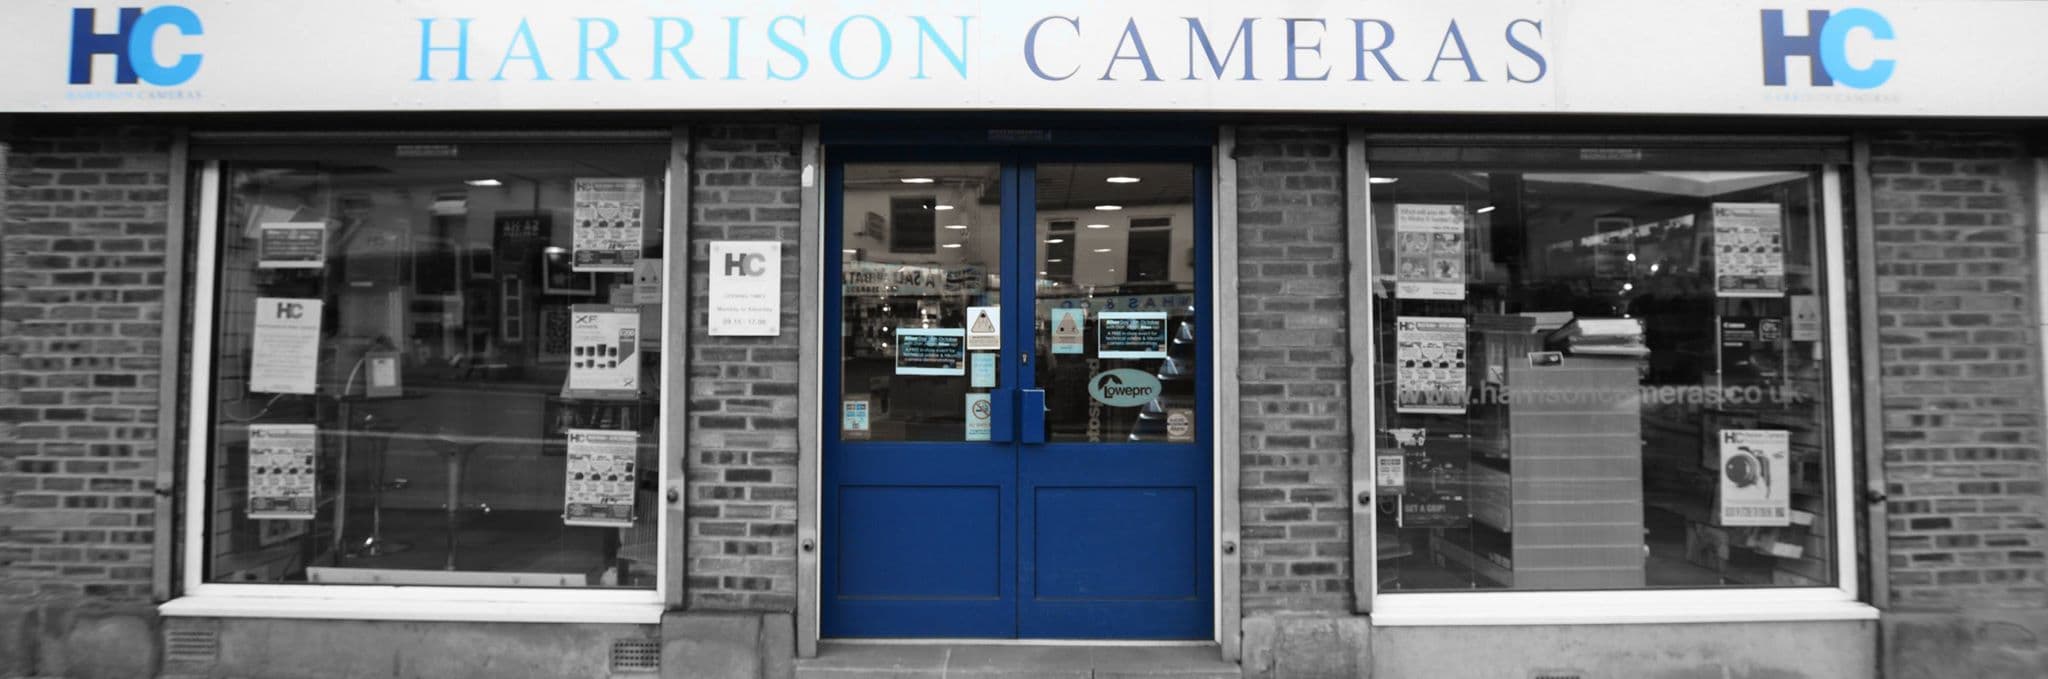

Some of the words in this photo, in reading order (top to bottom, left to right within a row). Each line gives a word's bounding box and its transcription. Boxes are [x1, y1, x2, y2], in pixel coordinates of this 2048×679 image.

[68, 5, 204, 86] HC
[414, 13, 976, 82] HARRISON
[1023, 15, 1548, 84] CAMERAS
[1760, 7, 1897, 90] HC
[725, 252, 767, 277] HC
[277, 302, 303, 319] HC
[1103, 384, 1153, 399] Lowepro
